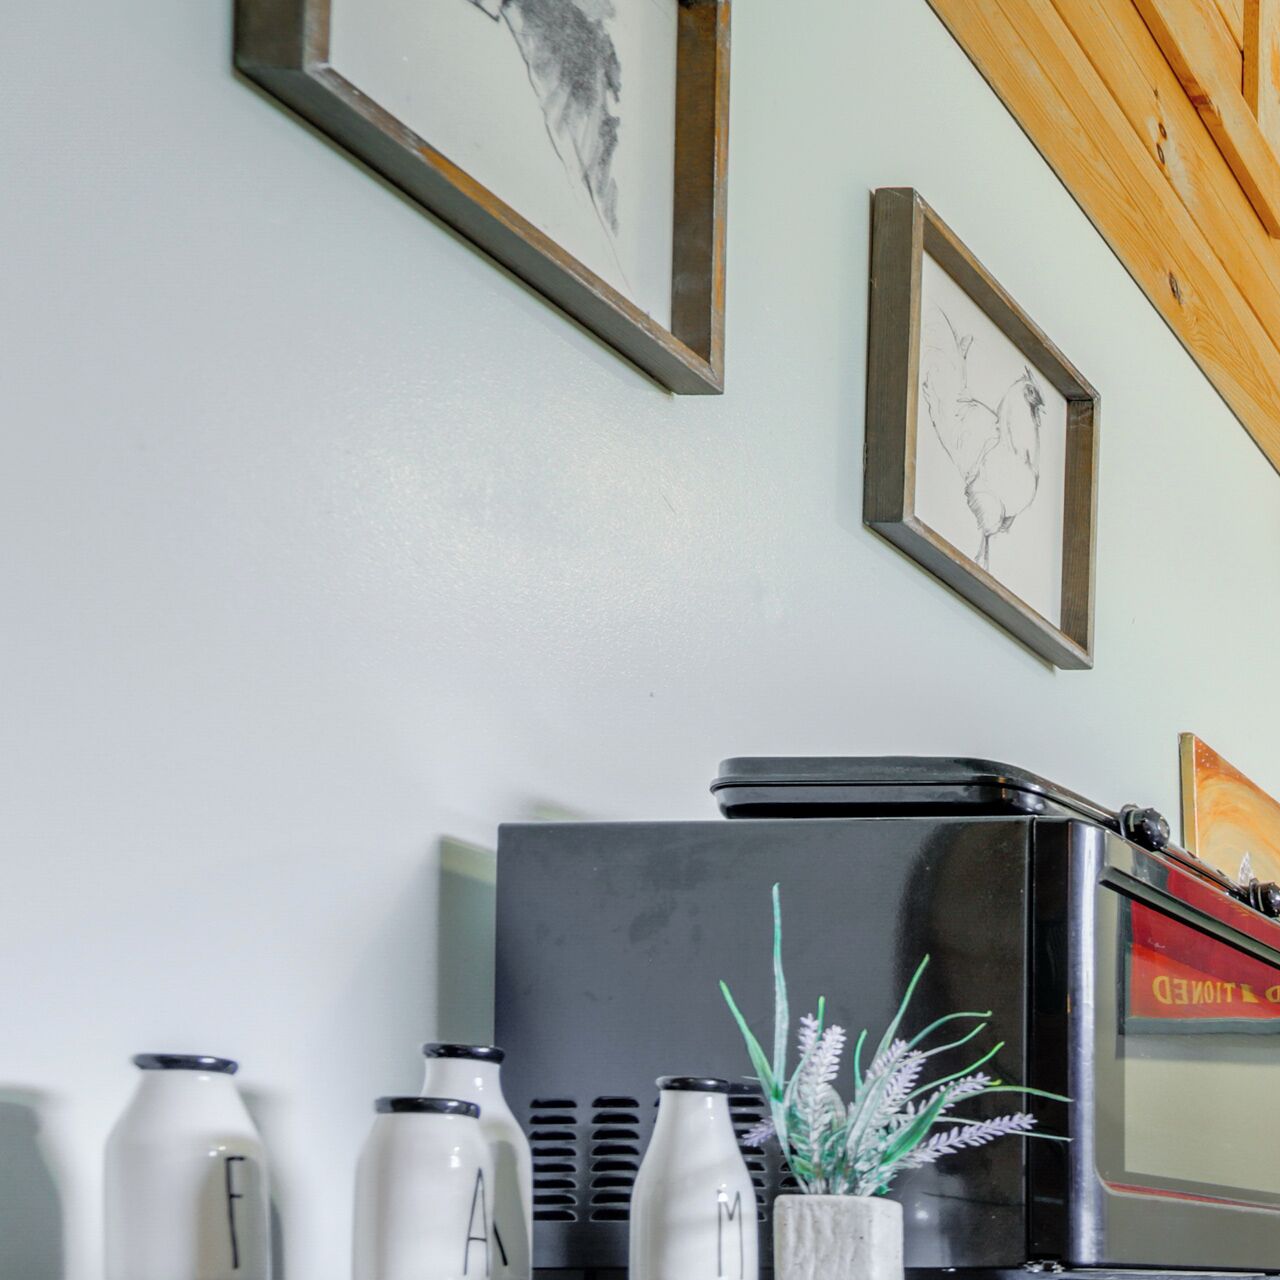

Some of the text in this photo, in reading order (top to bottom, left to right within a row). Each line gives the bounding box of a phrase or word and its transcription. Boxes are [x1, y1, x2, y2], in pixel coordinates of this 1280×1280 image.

[225, 1155, 246, 1270] F
[462, 1166, 492, 1278] A
[717, 1187, 745, 1280] M
